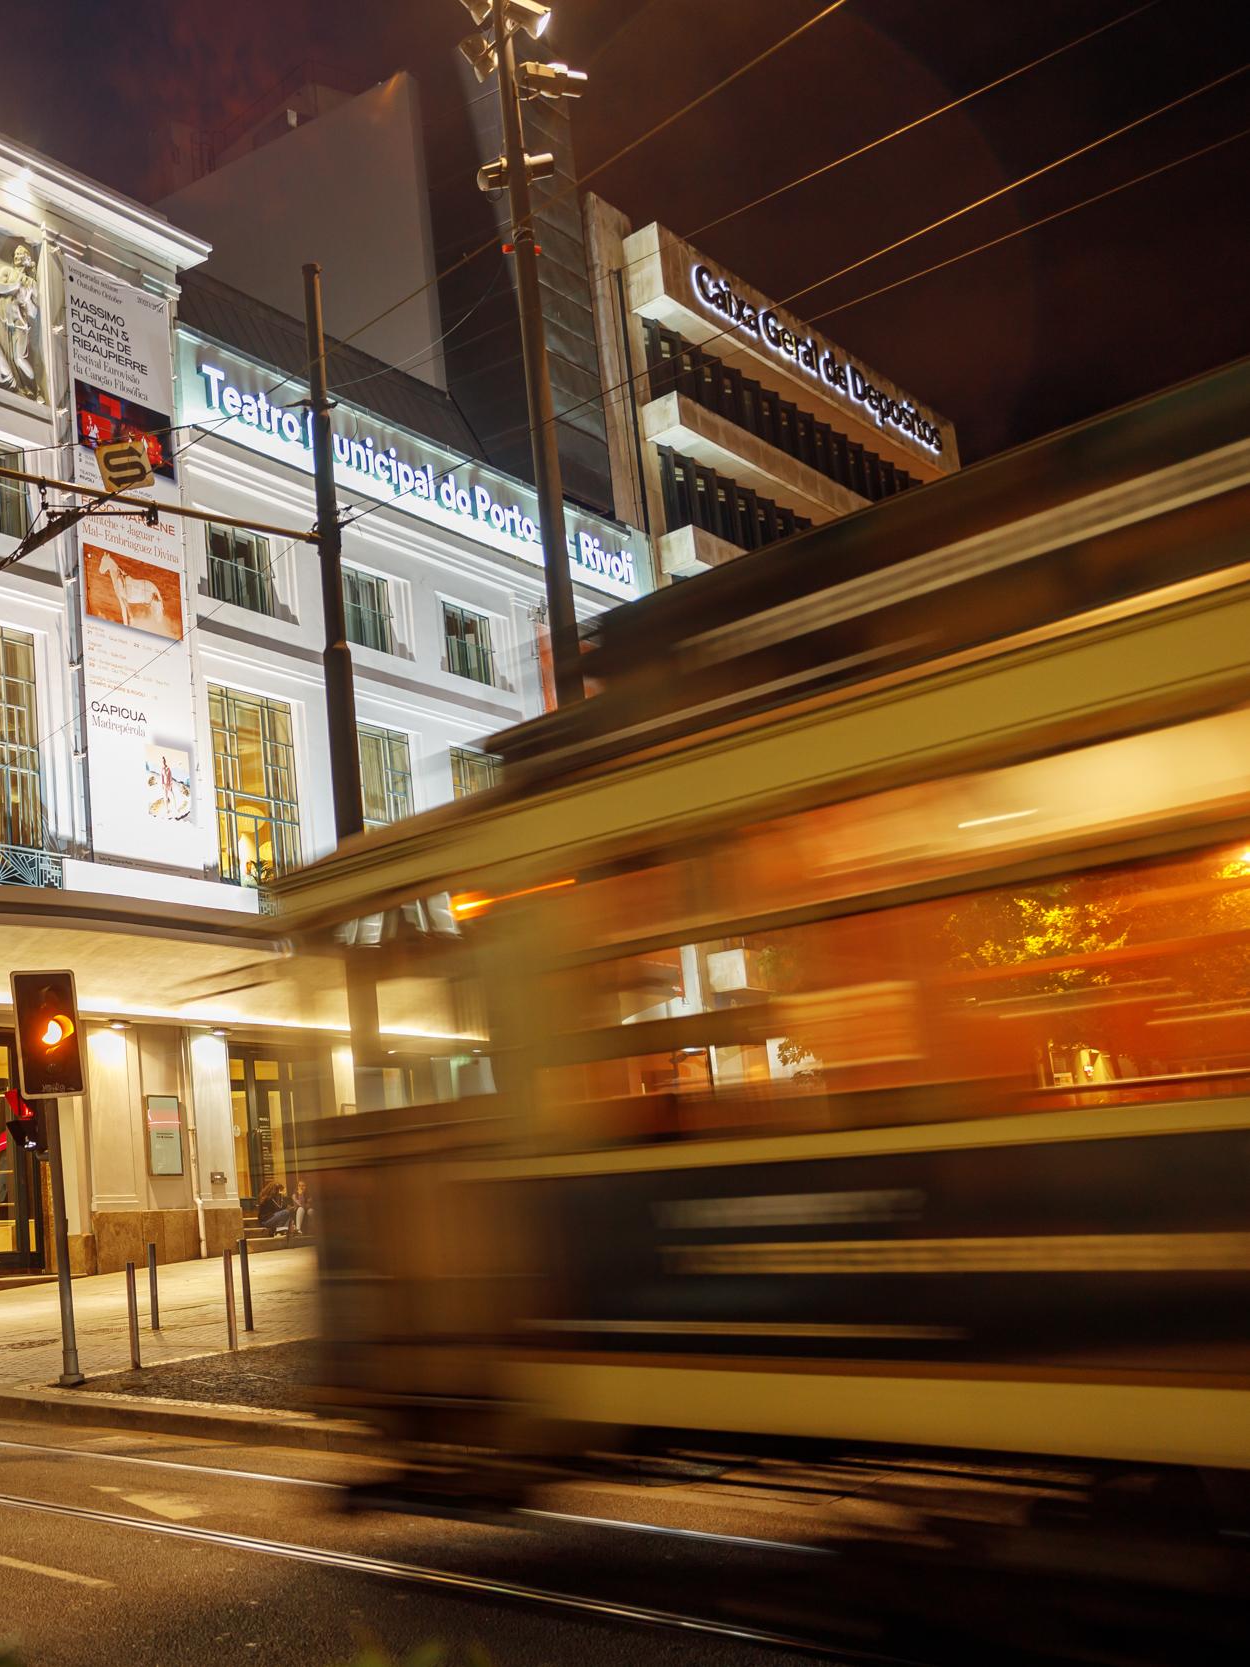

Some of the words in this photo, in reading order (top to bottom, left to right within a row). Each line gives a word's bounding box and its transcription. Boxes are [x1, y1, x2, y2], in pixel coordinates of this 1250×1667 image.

[70, 295, 125, 328] MASSIMO
[71, 309, 119, 338] FURLAN
[121, 331, 130, 343] &
[71, 323, 115, 350] CLAIRE
[116, 341, 132, 356] DE
[692, 265, 758, 338] Caixa
[759, 310, 818, 376] Geral
[819, 350, 848, 395] de
[72, 336, 149, 376] RIBAUPIERRE
[73, 349, 101, 369] Festival
[103, 359, 141, 386] Eurovisão
[73, 363, 83, 375] da
[84, 367, 113, 388] Canção
[114, 378, 149, 402] Filosófica
[200, 363, 302, 442] Teatro
[304, 412, 436, 499] unicipal
[440, 474, 472, 516] do
[473, 484, 537, 544] Porto
[579, 530, 635, 586] Rivoli
[105, 531, 151, 556] Embriaguez
[154, 545, 179, 564] Divina
[127, 524, 155, 543] Jaguar
[91, 701, 147, 724] CAPICUA
[92, 715, 146, 737] Madrepérola
